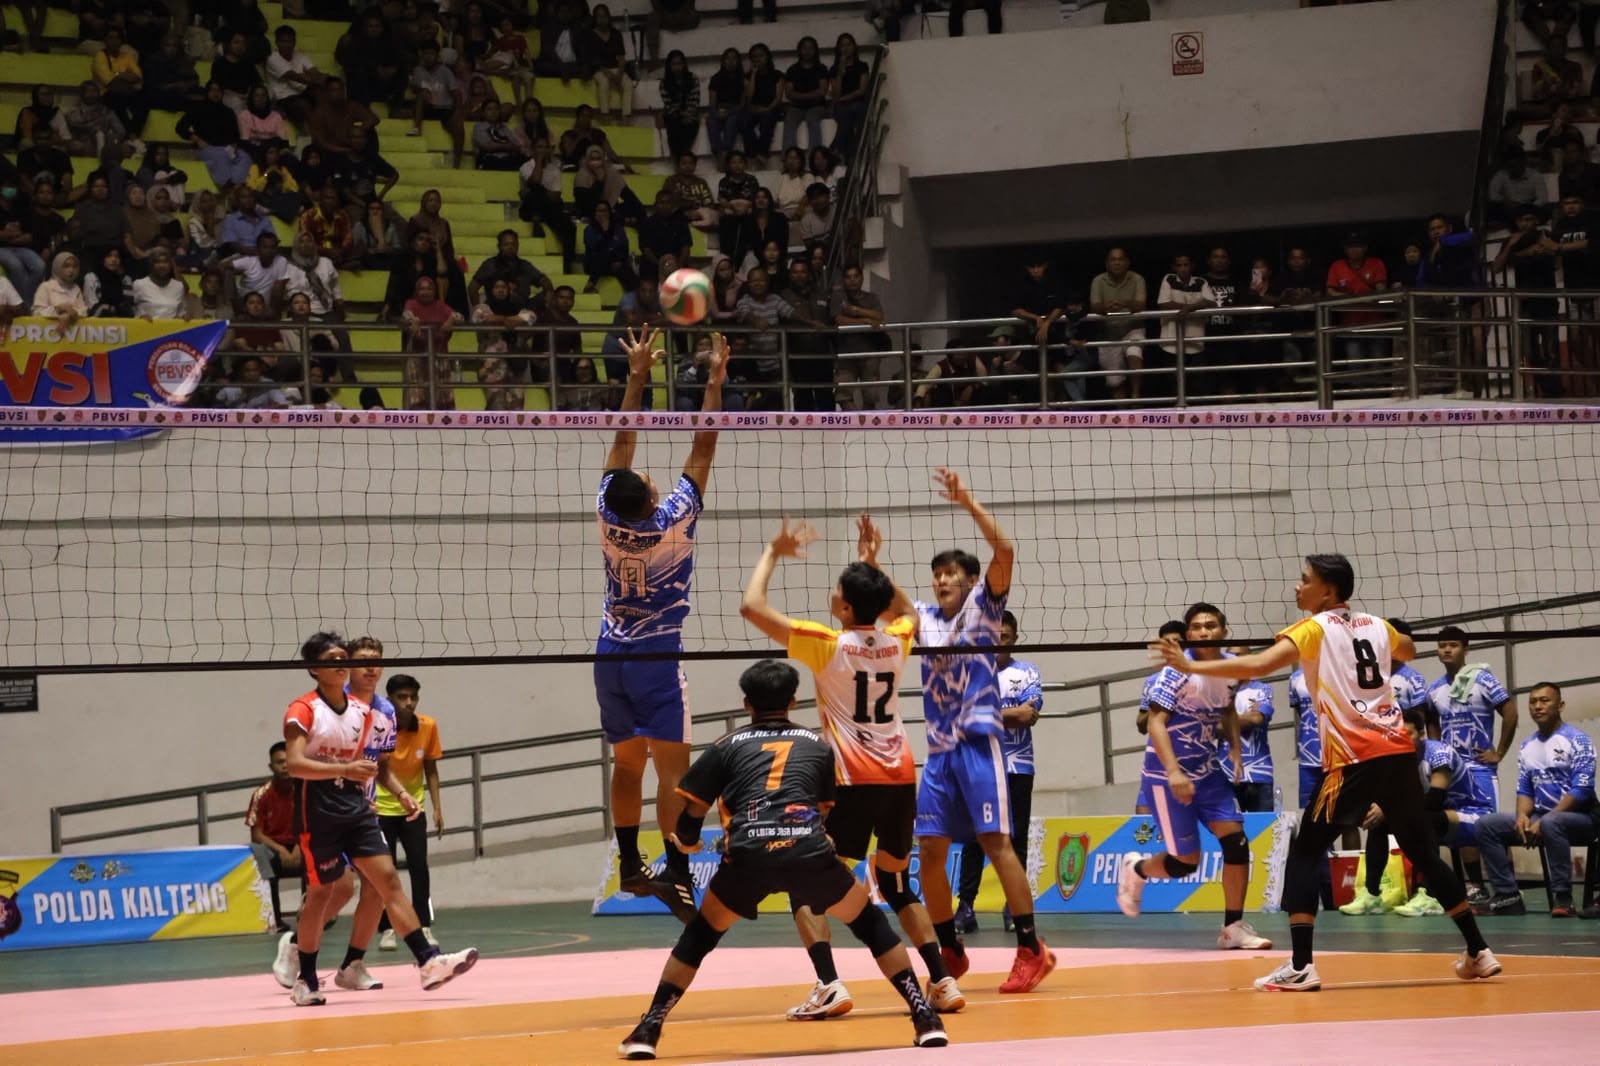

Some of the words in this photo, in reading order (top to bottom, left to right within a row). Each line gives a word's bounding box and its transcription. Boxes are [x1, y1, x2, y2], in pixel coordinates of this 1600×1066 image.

[10, 324, 127, 343] PROVINSI
[92, 412, 129, 422] PBVSI
[192, 413, 228, 423] PBVSI
[288, 413, 323, 423] PBVSI
[384, 415, 418, 424] PBVSI
[476, 415, 509, 424] PBVSI
[565, 416, 597, 425] PBVSI
[652, 416, 684, 425] PBVSI
[737, 416, 768, 425] PBVSI
[821, 416, 851, 425] PBVSI
[903, 416, 933, 424] PBVSI
[983, 416, 1014, 424] PBVSI
[1063, 415, 1093, 424] PBVSI
[1142, 415, 1171, 424] PBVSI
[1220, 414, 1248, 423] PBVSI
[1296, 413, 1325, 422] PBVSI
[1372, 413, 1401, 422] PBVSI
[1448, 412, 1476, 421] PBVSI
[1523, 411, 1551, 419] PBVSI
[1352, 637, 1384, 690] 8
[852, 670, 895, 724] 12
[761, 740, 794, 791] 7
[983, 802, 993, 824] 6
[33, 888, 115, 925] POLDA
[122, 882, 229, 919] KALTENG
